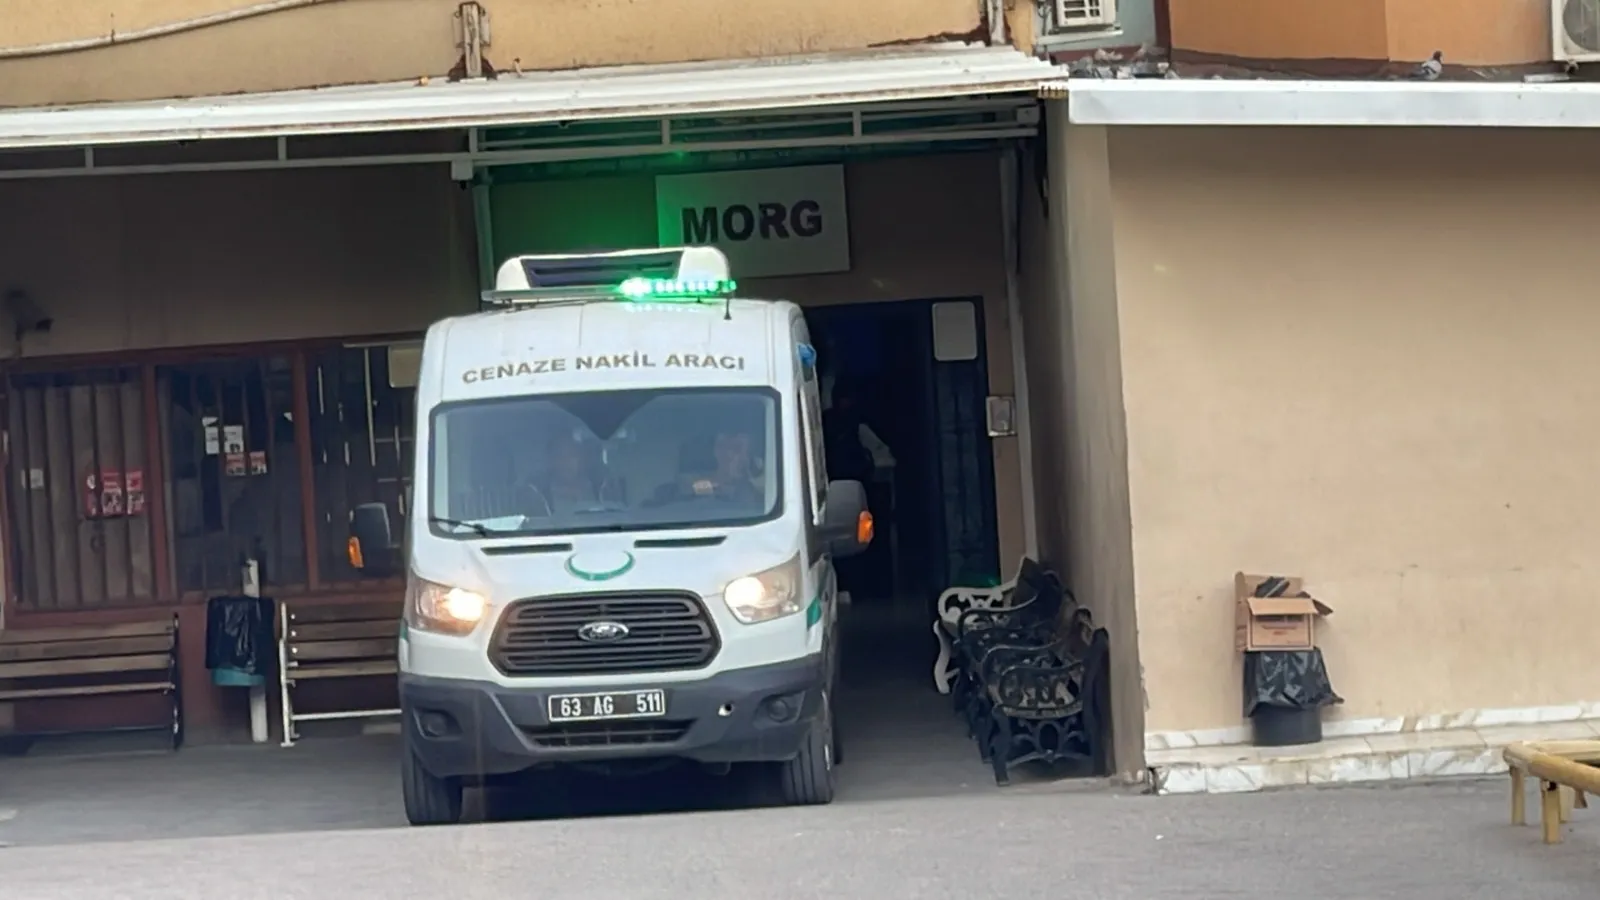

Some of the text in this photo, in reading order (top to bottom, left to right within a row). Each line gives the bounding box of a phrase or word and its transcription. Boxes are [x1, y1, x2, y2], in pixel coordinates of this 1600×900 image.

[682, 200, 822, 244] MORG
[462, 350, 745, 384] CENAZE NAKİL ARACI
[561, 693, 661, 716] 63 AG 511
